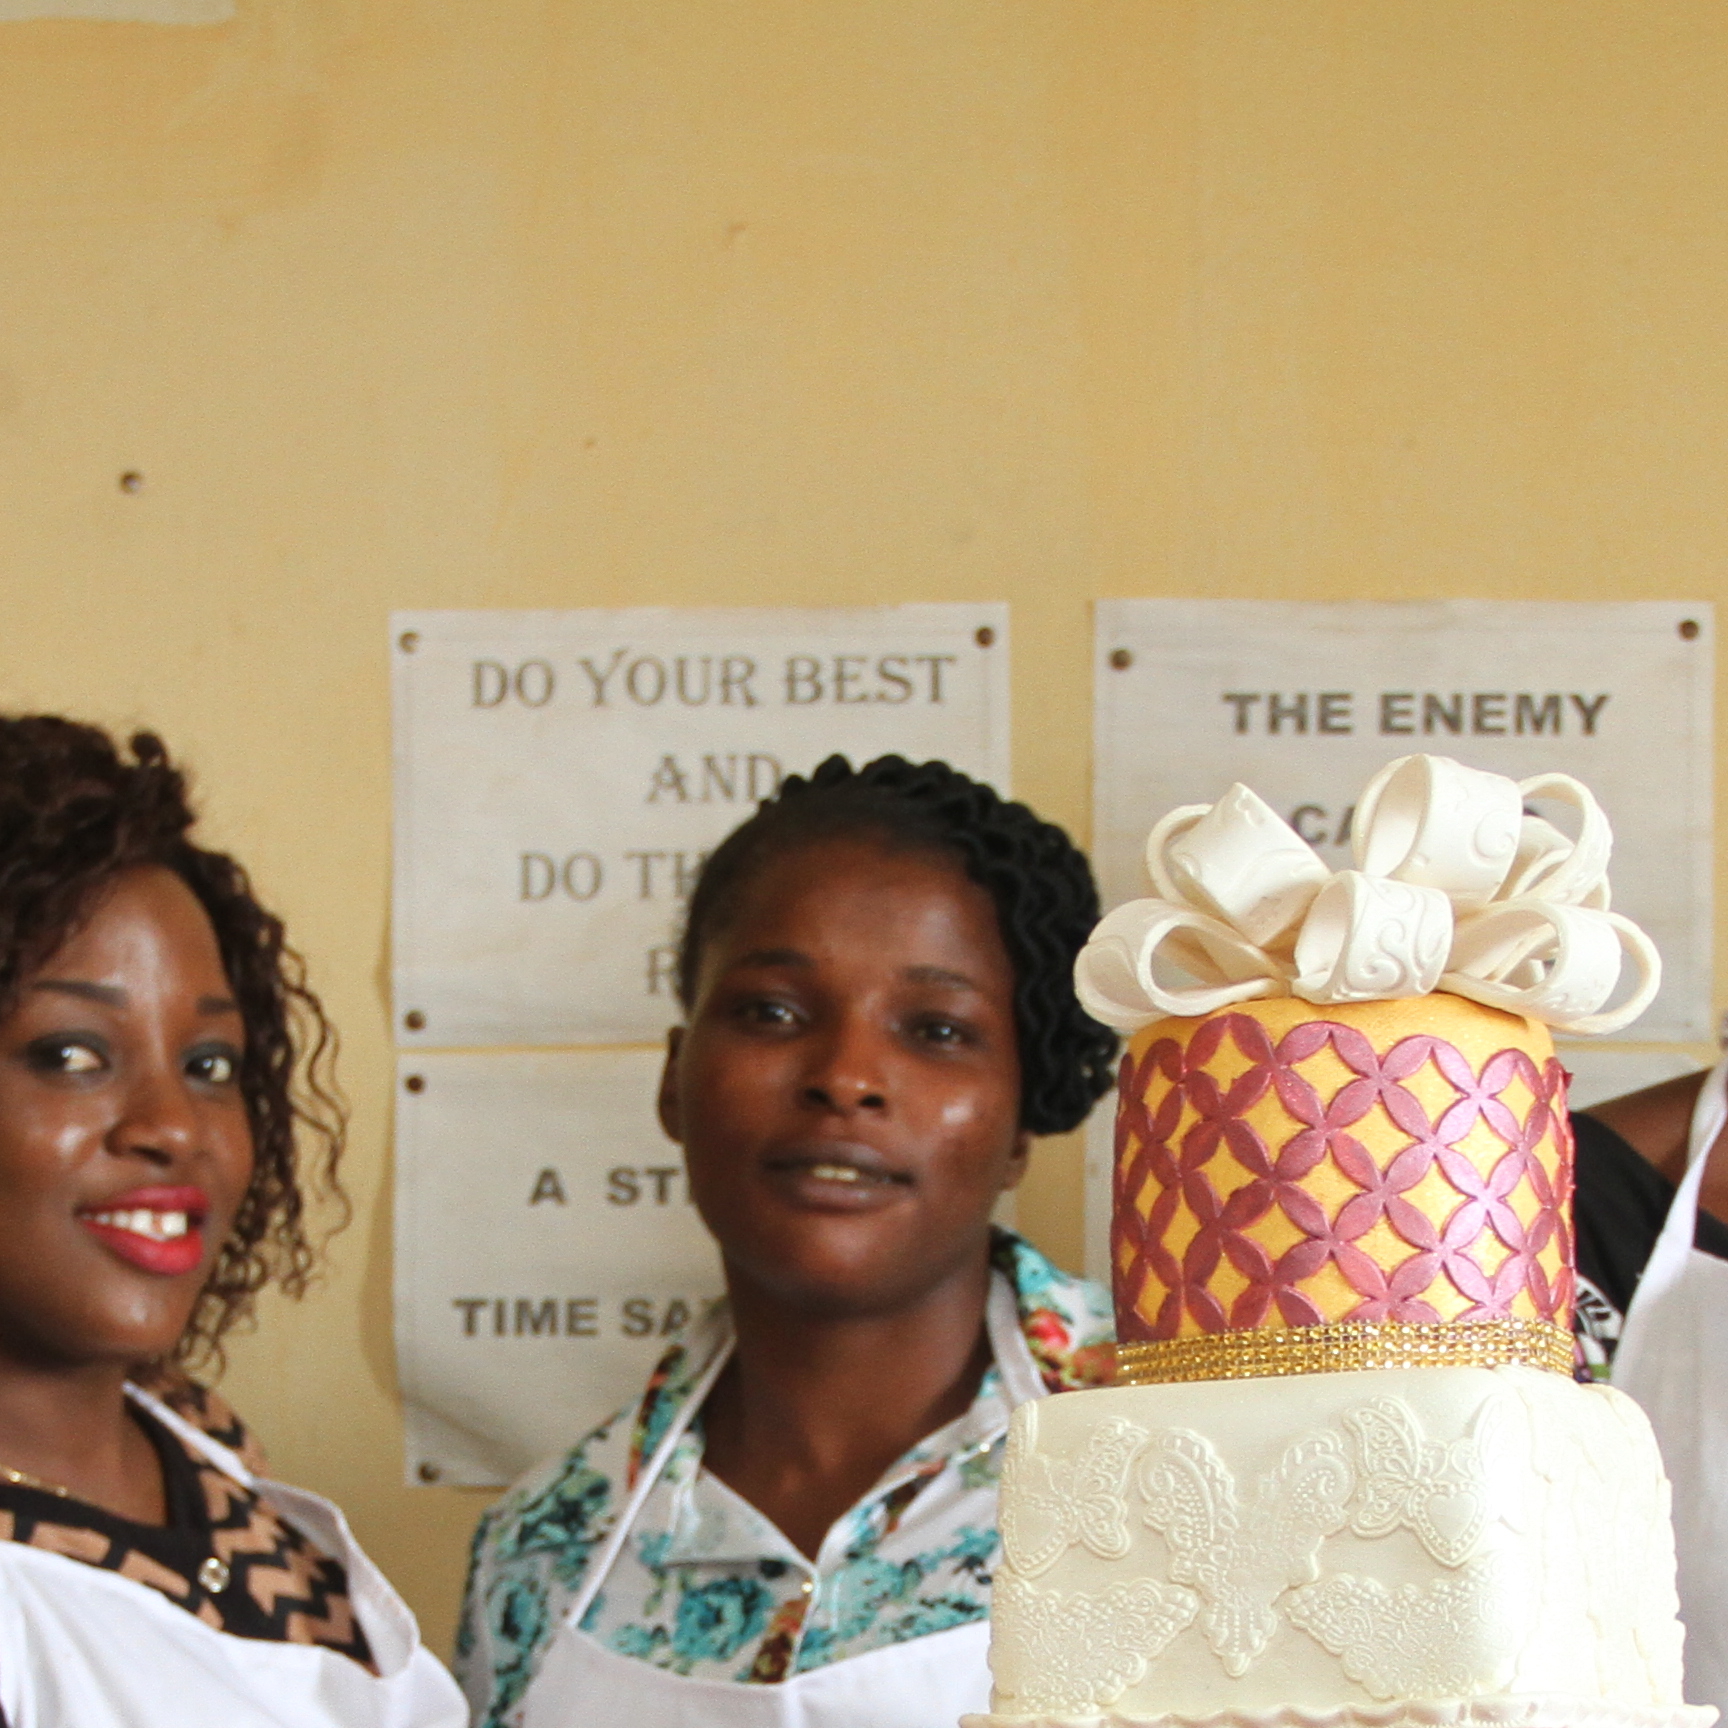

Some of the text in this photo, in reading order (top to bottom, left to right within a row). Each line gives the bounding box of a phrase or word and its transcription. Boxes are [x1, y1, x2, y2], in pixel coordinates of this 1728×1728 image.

[472, 650, 957, 709] DO YOUR BEST
[1221, 691, 1611, 737] THE ENEMY
[646, 753, 783, 803] AND
[520, 852, 604, 902] DO
[528, 1167, 568, 1207] A
[452, 1296, 600, 1339] TIME
